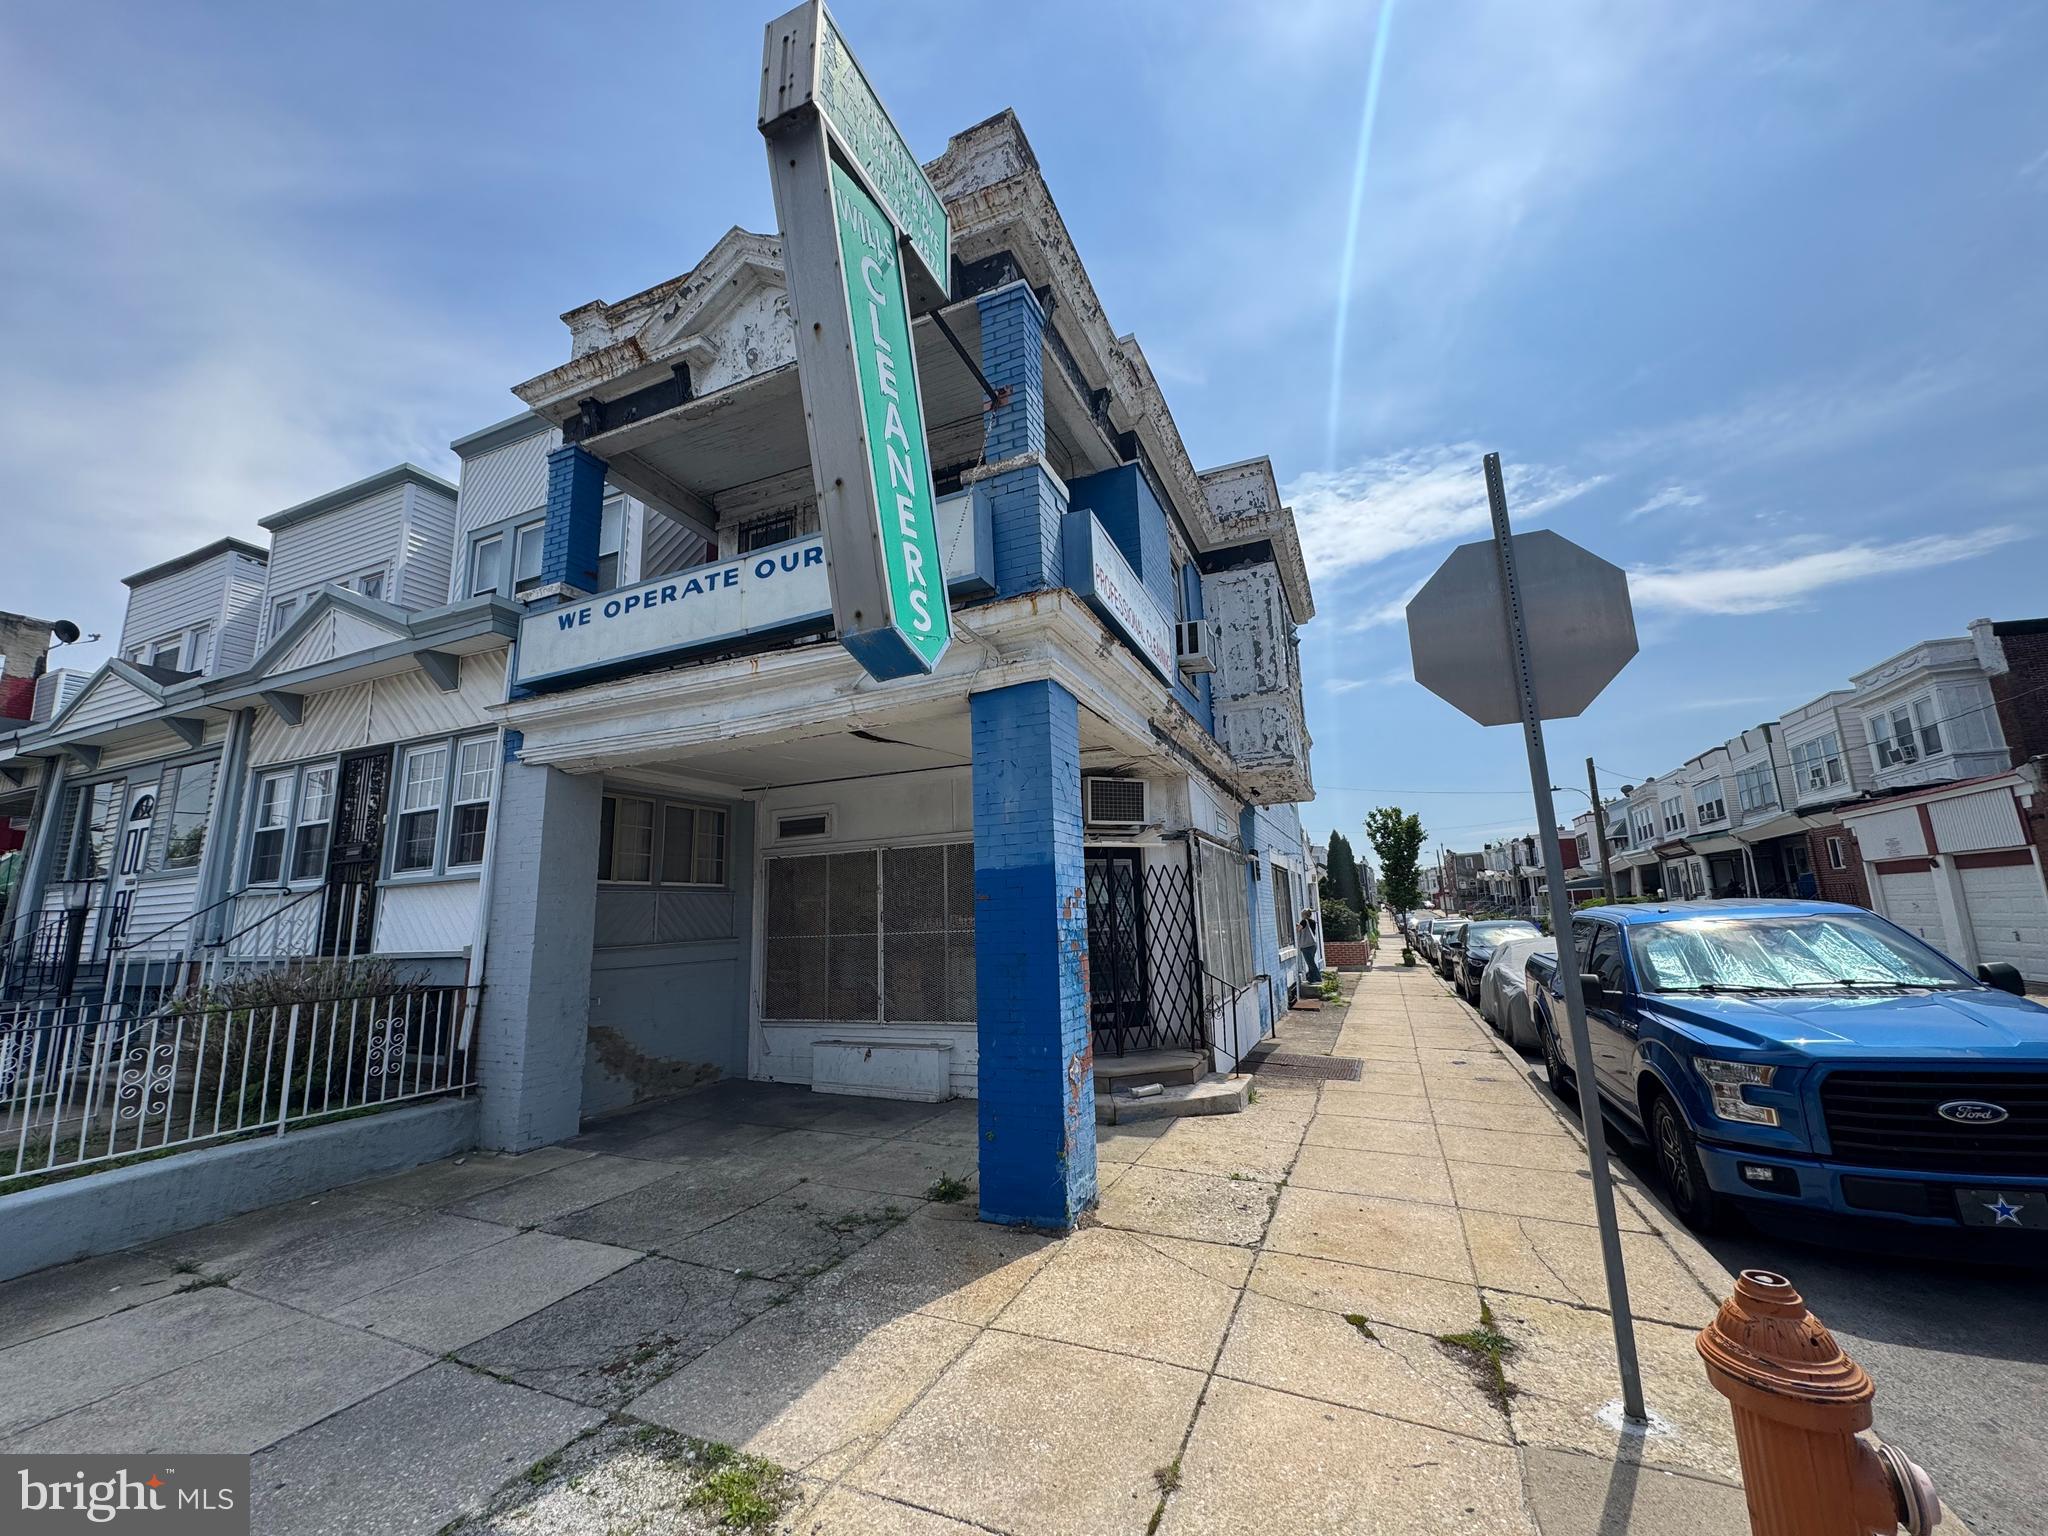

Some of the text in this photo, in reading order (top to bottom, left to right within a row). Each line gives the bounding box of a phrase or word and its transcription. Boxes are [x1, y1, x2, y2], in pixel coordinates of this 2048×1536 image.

[843, 64, 934, 219] ALTERATION
[835, 187, 895, 267] WILLS
[922, 213, 940, 255] DYE
[861, 255, 932, 632] CLEANERS
[558, 546, 823, 631] WE OPERATE OUR
[1095, 562, 1146, 644] PROFESSIONAL
[1956, 1105, 1992, 1119] Ford
